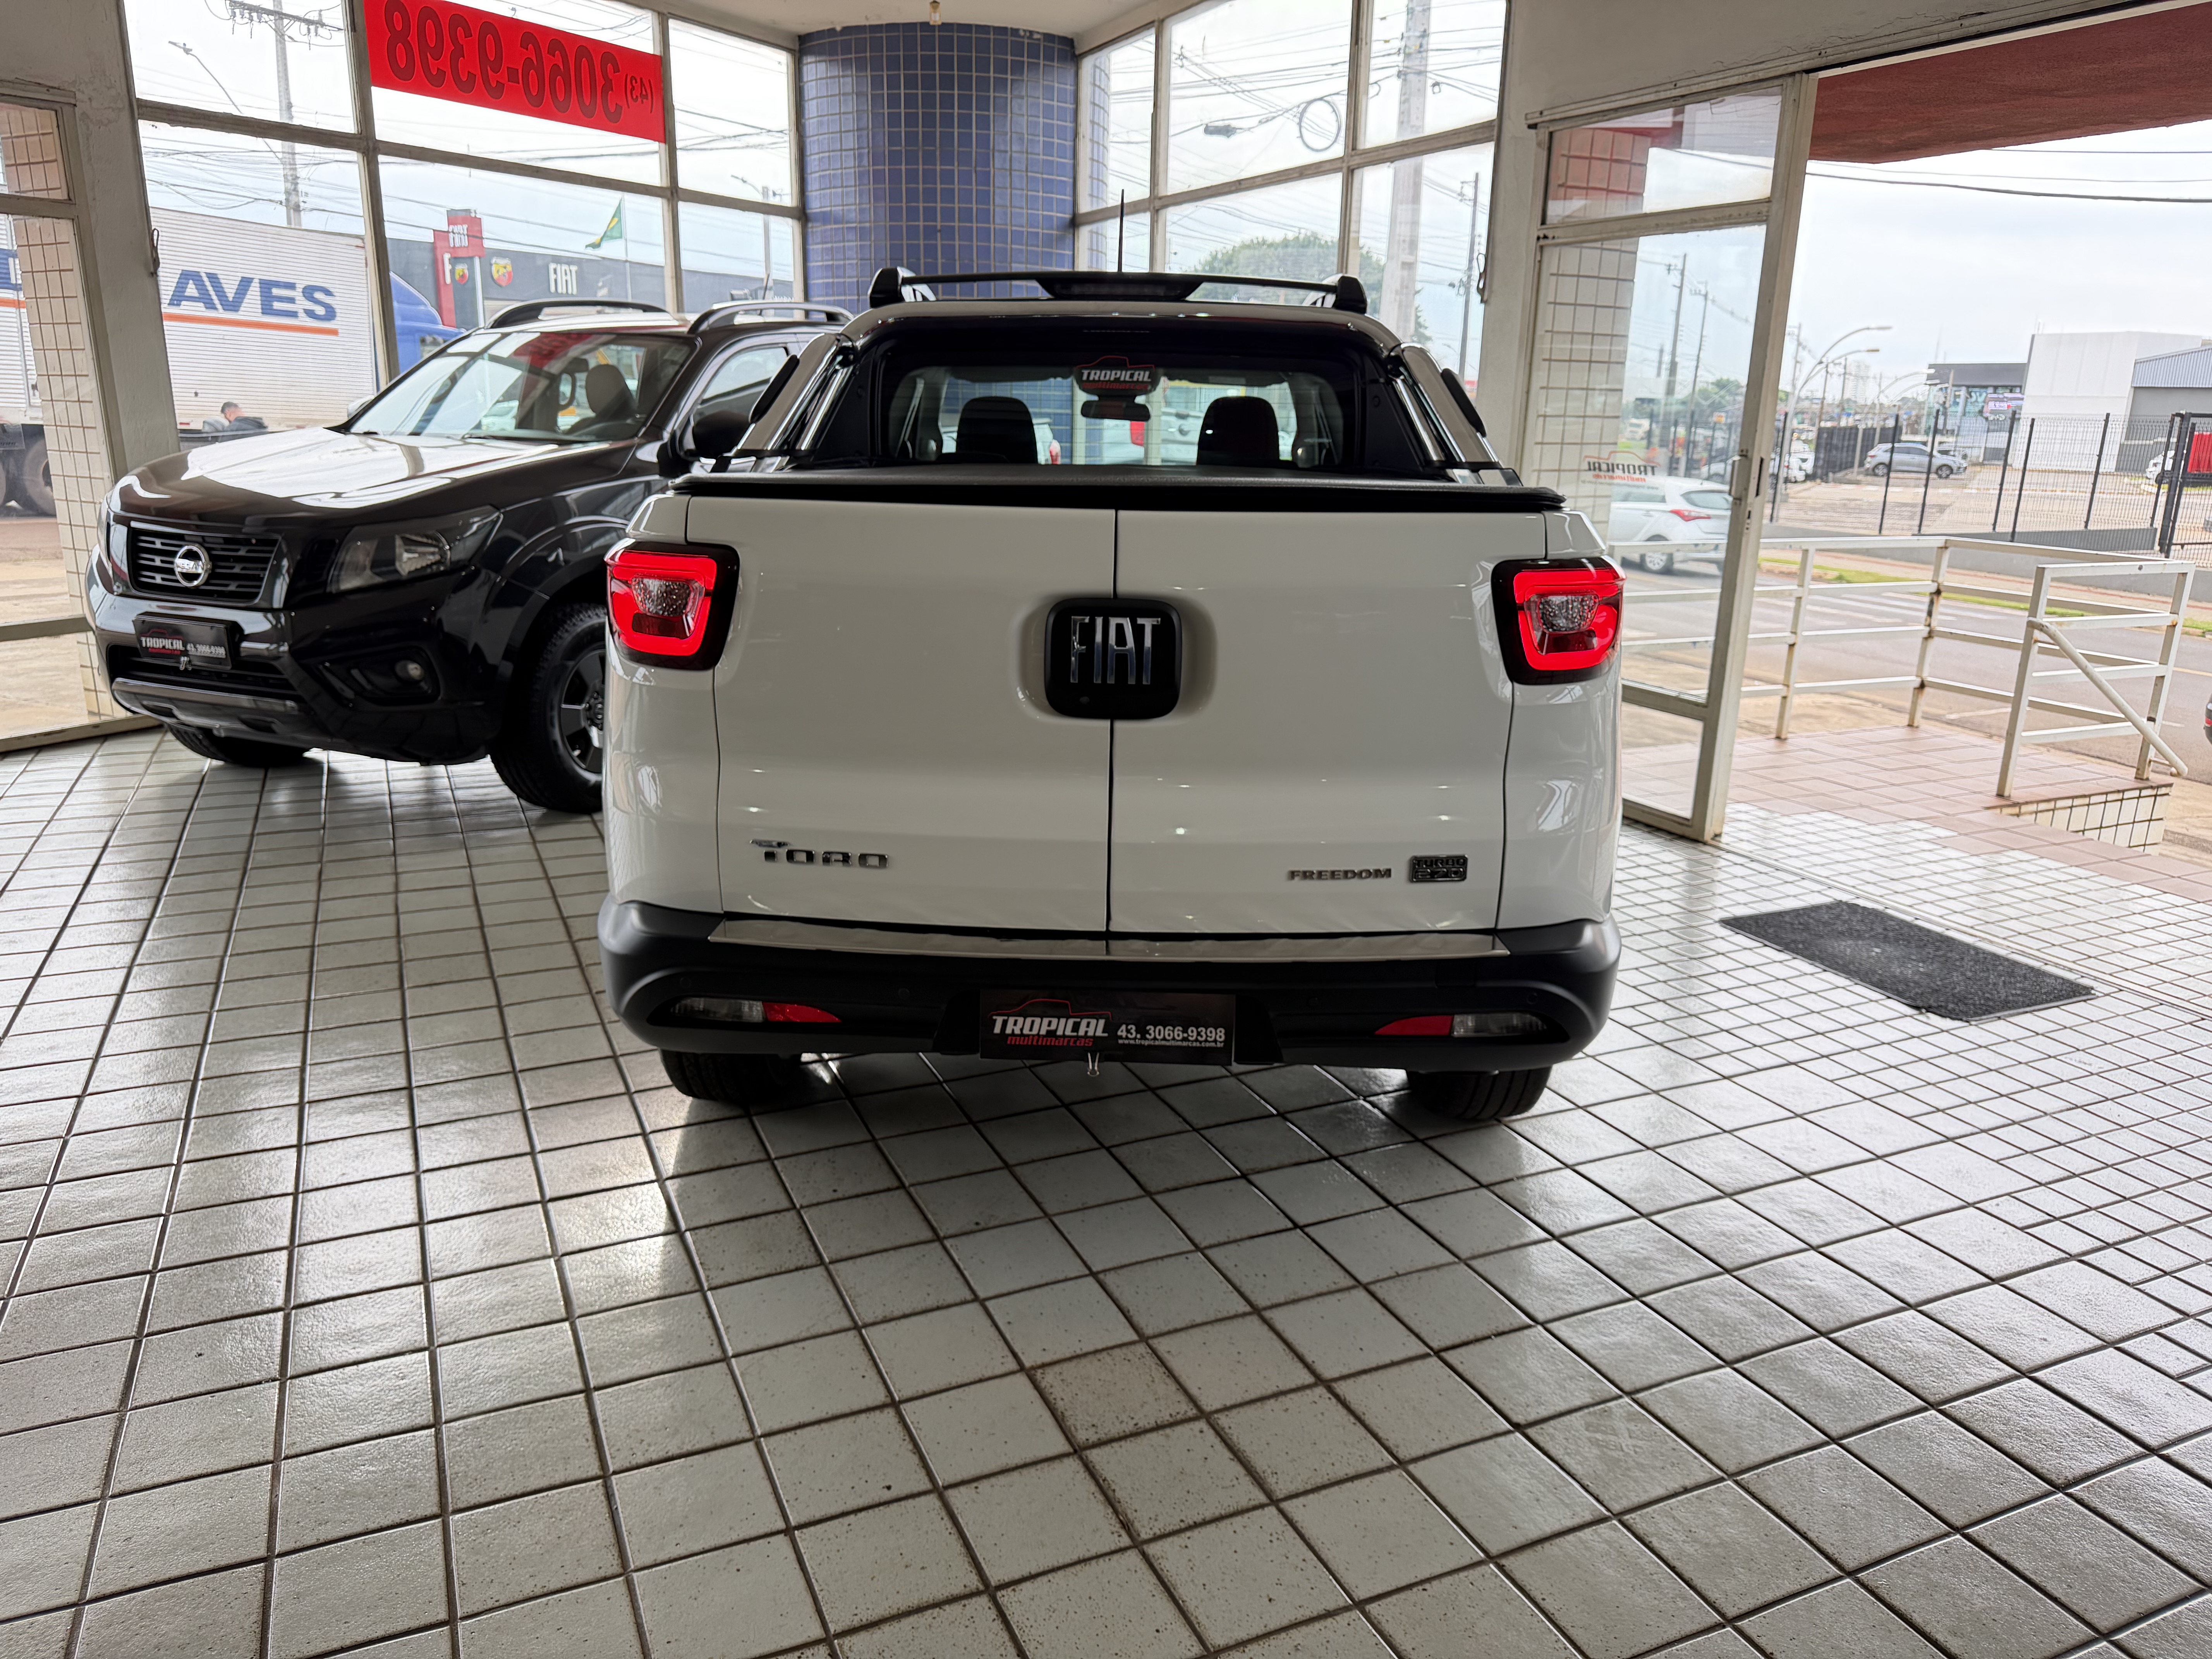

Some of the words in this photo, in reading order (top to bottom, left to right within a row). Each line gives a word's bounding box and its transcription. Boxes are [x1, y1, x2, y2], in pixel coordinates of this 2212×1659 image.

[548, 262, 578, 295] FIAT
[167, 269, 337, 322] AVES
[1081, 369, 1152, 381] TROPICAL
[140, 636, 185, 651] TROPICAL
[1070, 615, 1161, 685] FIAT
[749, 838, 889, 869] TORO
[1413, 858, 1466, 867] TURBO
[1288, 868, 1392, 881] FREEDOM
[1413, 867, 1465, 879] 270
[992, 1015, 1109, 1037] TROPICAL
[1117, 1024, 1141, 1039] 43.
[1145, 1025, 1226, 1042] 3066-9398
[1007, 1036, 1094, 1047] multimarcas
[1118, 1038, 1224, 1048] www.tropicalmultimarcas.com.br
